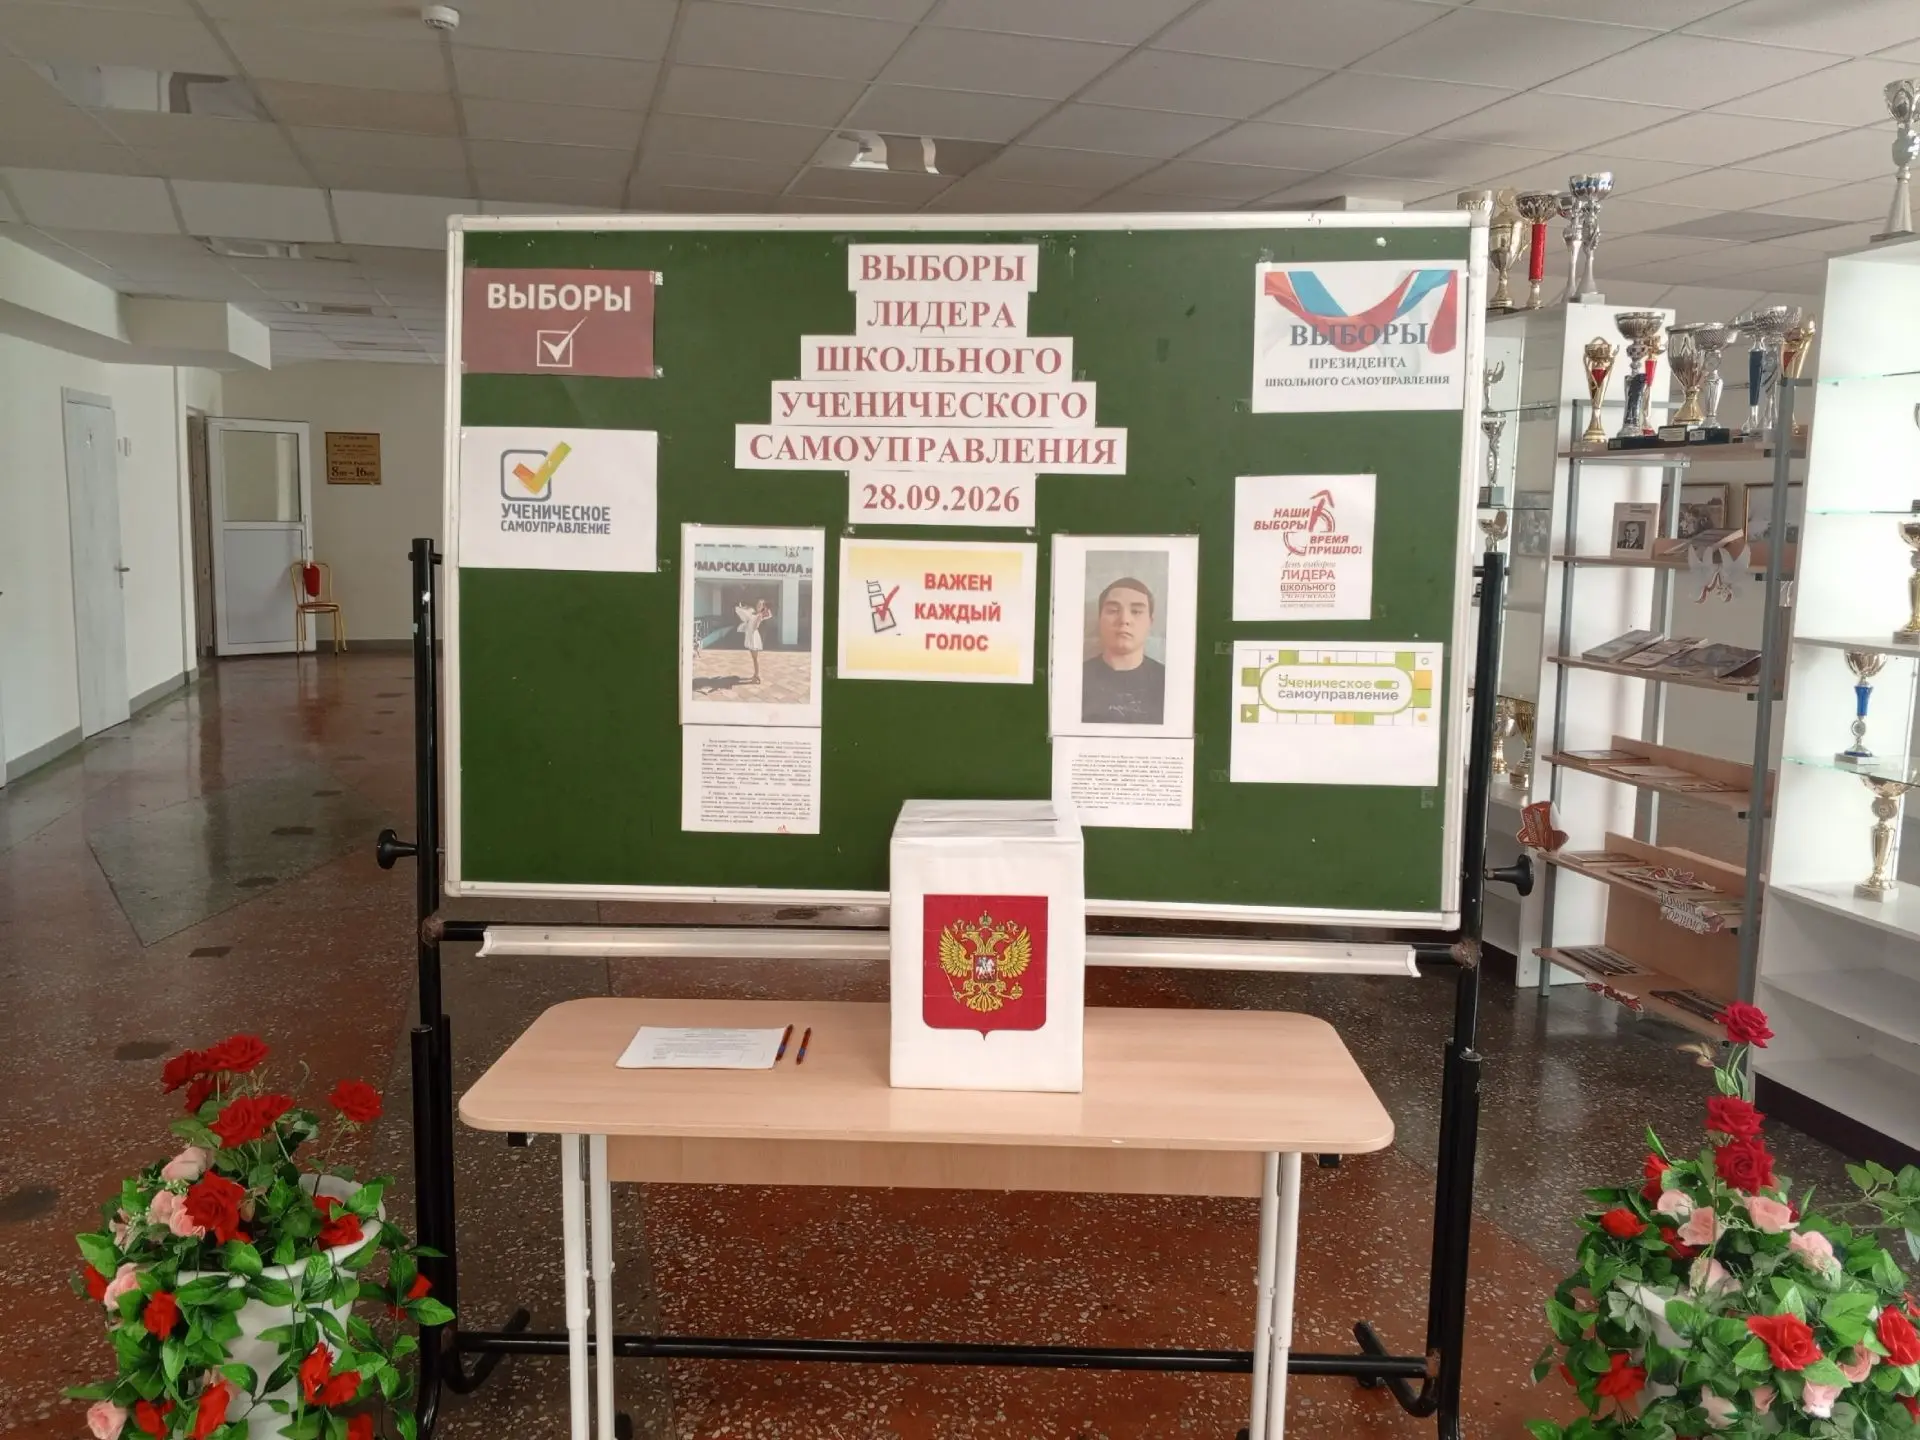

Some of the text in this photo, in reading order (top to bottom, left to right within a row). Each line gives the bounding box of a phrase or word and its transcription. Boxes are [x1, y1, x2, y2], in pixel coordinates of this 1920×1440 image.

[859, 254, 1026, 282] ВЫБОРЫ
[487, 283, 631, 312] ВЫБОРЫ
[866, 300, 1016, 333] ЛИДЕРА
[1289, 323, 1429, 347] ВЫБОРЫ
[815, 345, 1062, 374] ШКОЛЬНОГО
[1308, 356, 1407, 370] ПРЕЗИДЕНТА
[1264, 375, 1450, 388] ШКОЛЬНОГО САМОУПРАВЛЕНИЯ
[777, 391, 1087, 419] УЧЕНИЧЕСКОГО
[749, 433, 1117, 465] САМОУПРАВЛЕНИЯ
[862, 483, 1020, 512] 28.09.2026
[501, 503, 611, 521] УЧЕНИЧЕСКОЕ
[1273, 508, 1310, 518] НАШИ
[500, 520, 611, 535] САМОУПРАВЛЕНИЕ
[1253, 520, 1308, 531] ВЫБОРЫ
[1309, 535, 1349, 544] ВРЕМЯ
[1308, 546, 1362, 555] ПРИШЛО!
[758, 563, 803, 573] ШКОЛА
[1281, 569, 1336, 582] ЛИДЕРА
[924, 573, 992, 591] ВАЖЕН
[914, 601, 1001, 624] КАЖДЫЙ
[925, 633, 989, 652] ГОЛОС
[1278, 674, 1372, 689] Ученическое
[1278, 689, 1399, 702] самоуправление
